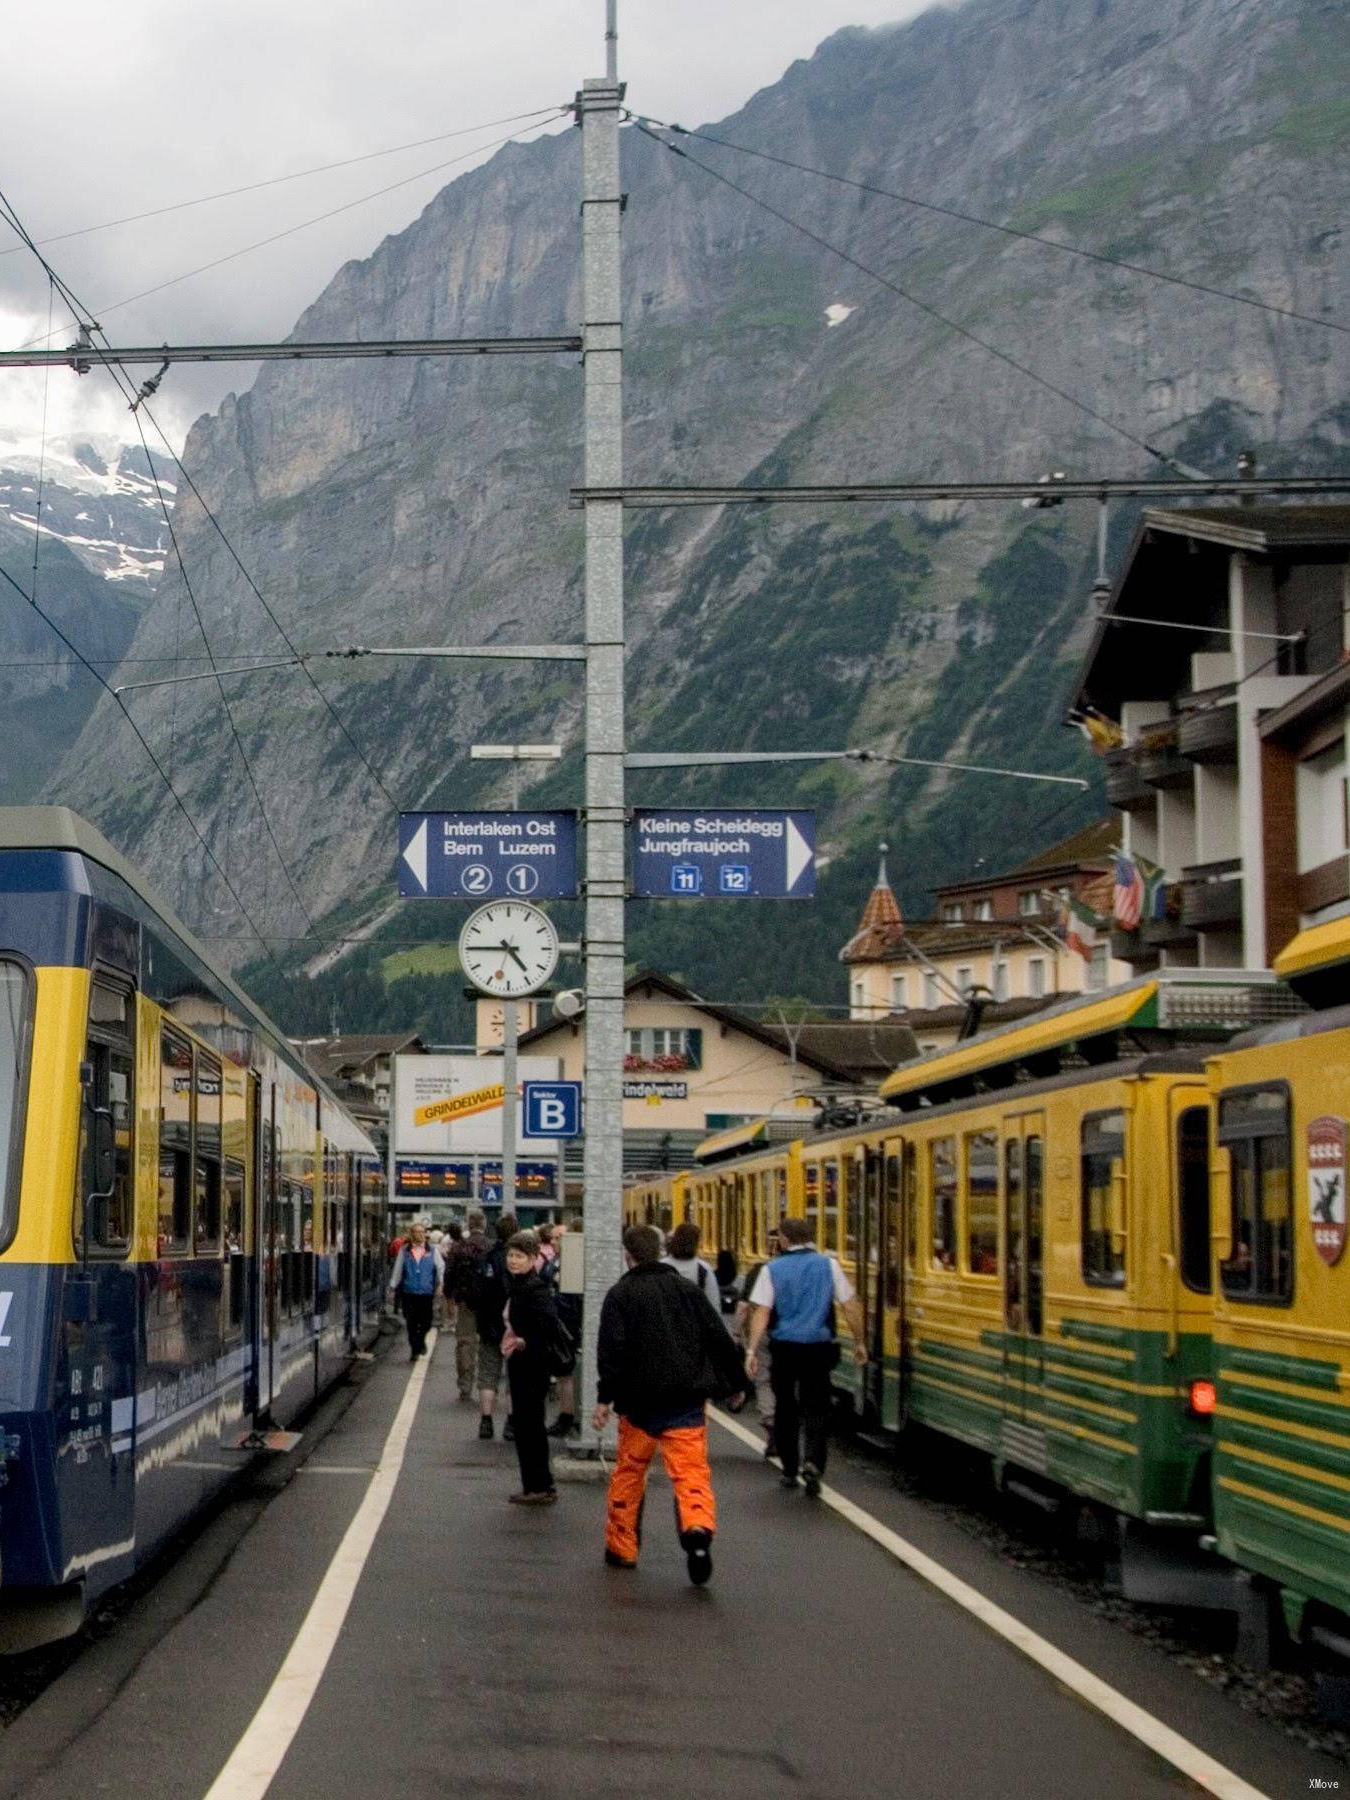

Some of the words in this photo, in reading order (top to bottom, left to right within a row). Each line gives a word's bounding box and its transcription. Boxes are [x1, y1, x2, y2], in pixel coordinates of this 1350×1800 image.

[444, 821, 522, 836] Interlaken
[526, 821, 556, 836] Ost
[639, 818, 691, 833] Kleine
[694, 818, 783, 837] Scheidegg
[444, 841, 483, 855] Bern
[499, 841, 556, 855] Luzern
[639, 838, 750, 856] Jungfraujoch
[468, 867, 485, 889] 2
[515, 867, 527, 890] 1
[677, 873, 694, 888] 11
[724, 872, 744, 888] 12
[424, 1086, 505, 1119] GRINDELWALD
[540, 1099, 566, 1130] B
[487, 1187, 498, 1200] A
